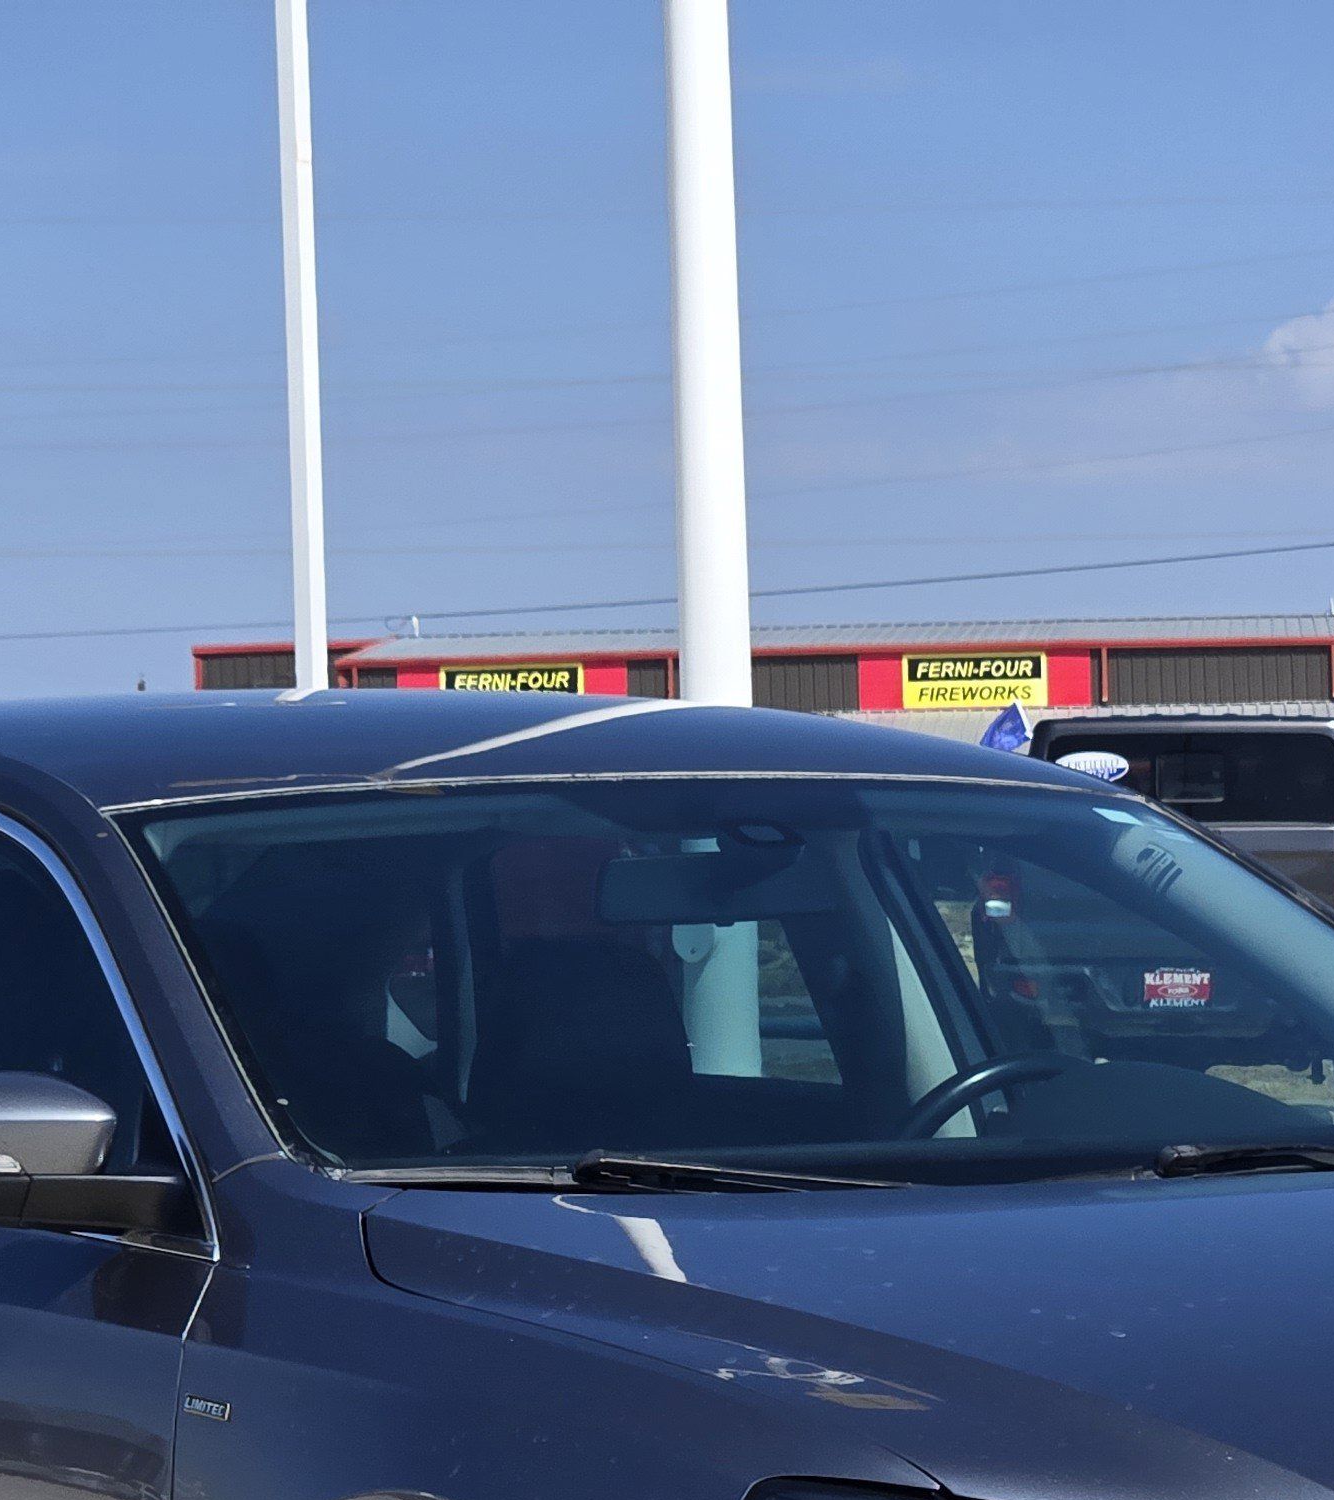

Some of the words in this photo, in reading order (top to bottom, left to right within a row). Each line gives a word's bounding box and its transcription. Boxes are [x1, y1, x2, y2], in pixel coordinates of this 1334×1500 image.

[916, 659, 1033, 679] FERNI-FOUR
[918, 685, 1032, 702] FIREWORKS
[1144, 972, 1211, 985] KLEMENT
[1149, 998, 1206, 1008] KLEMENT
